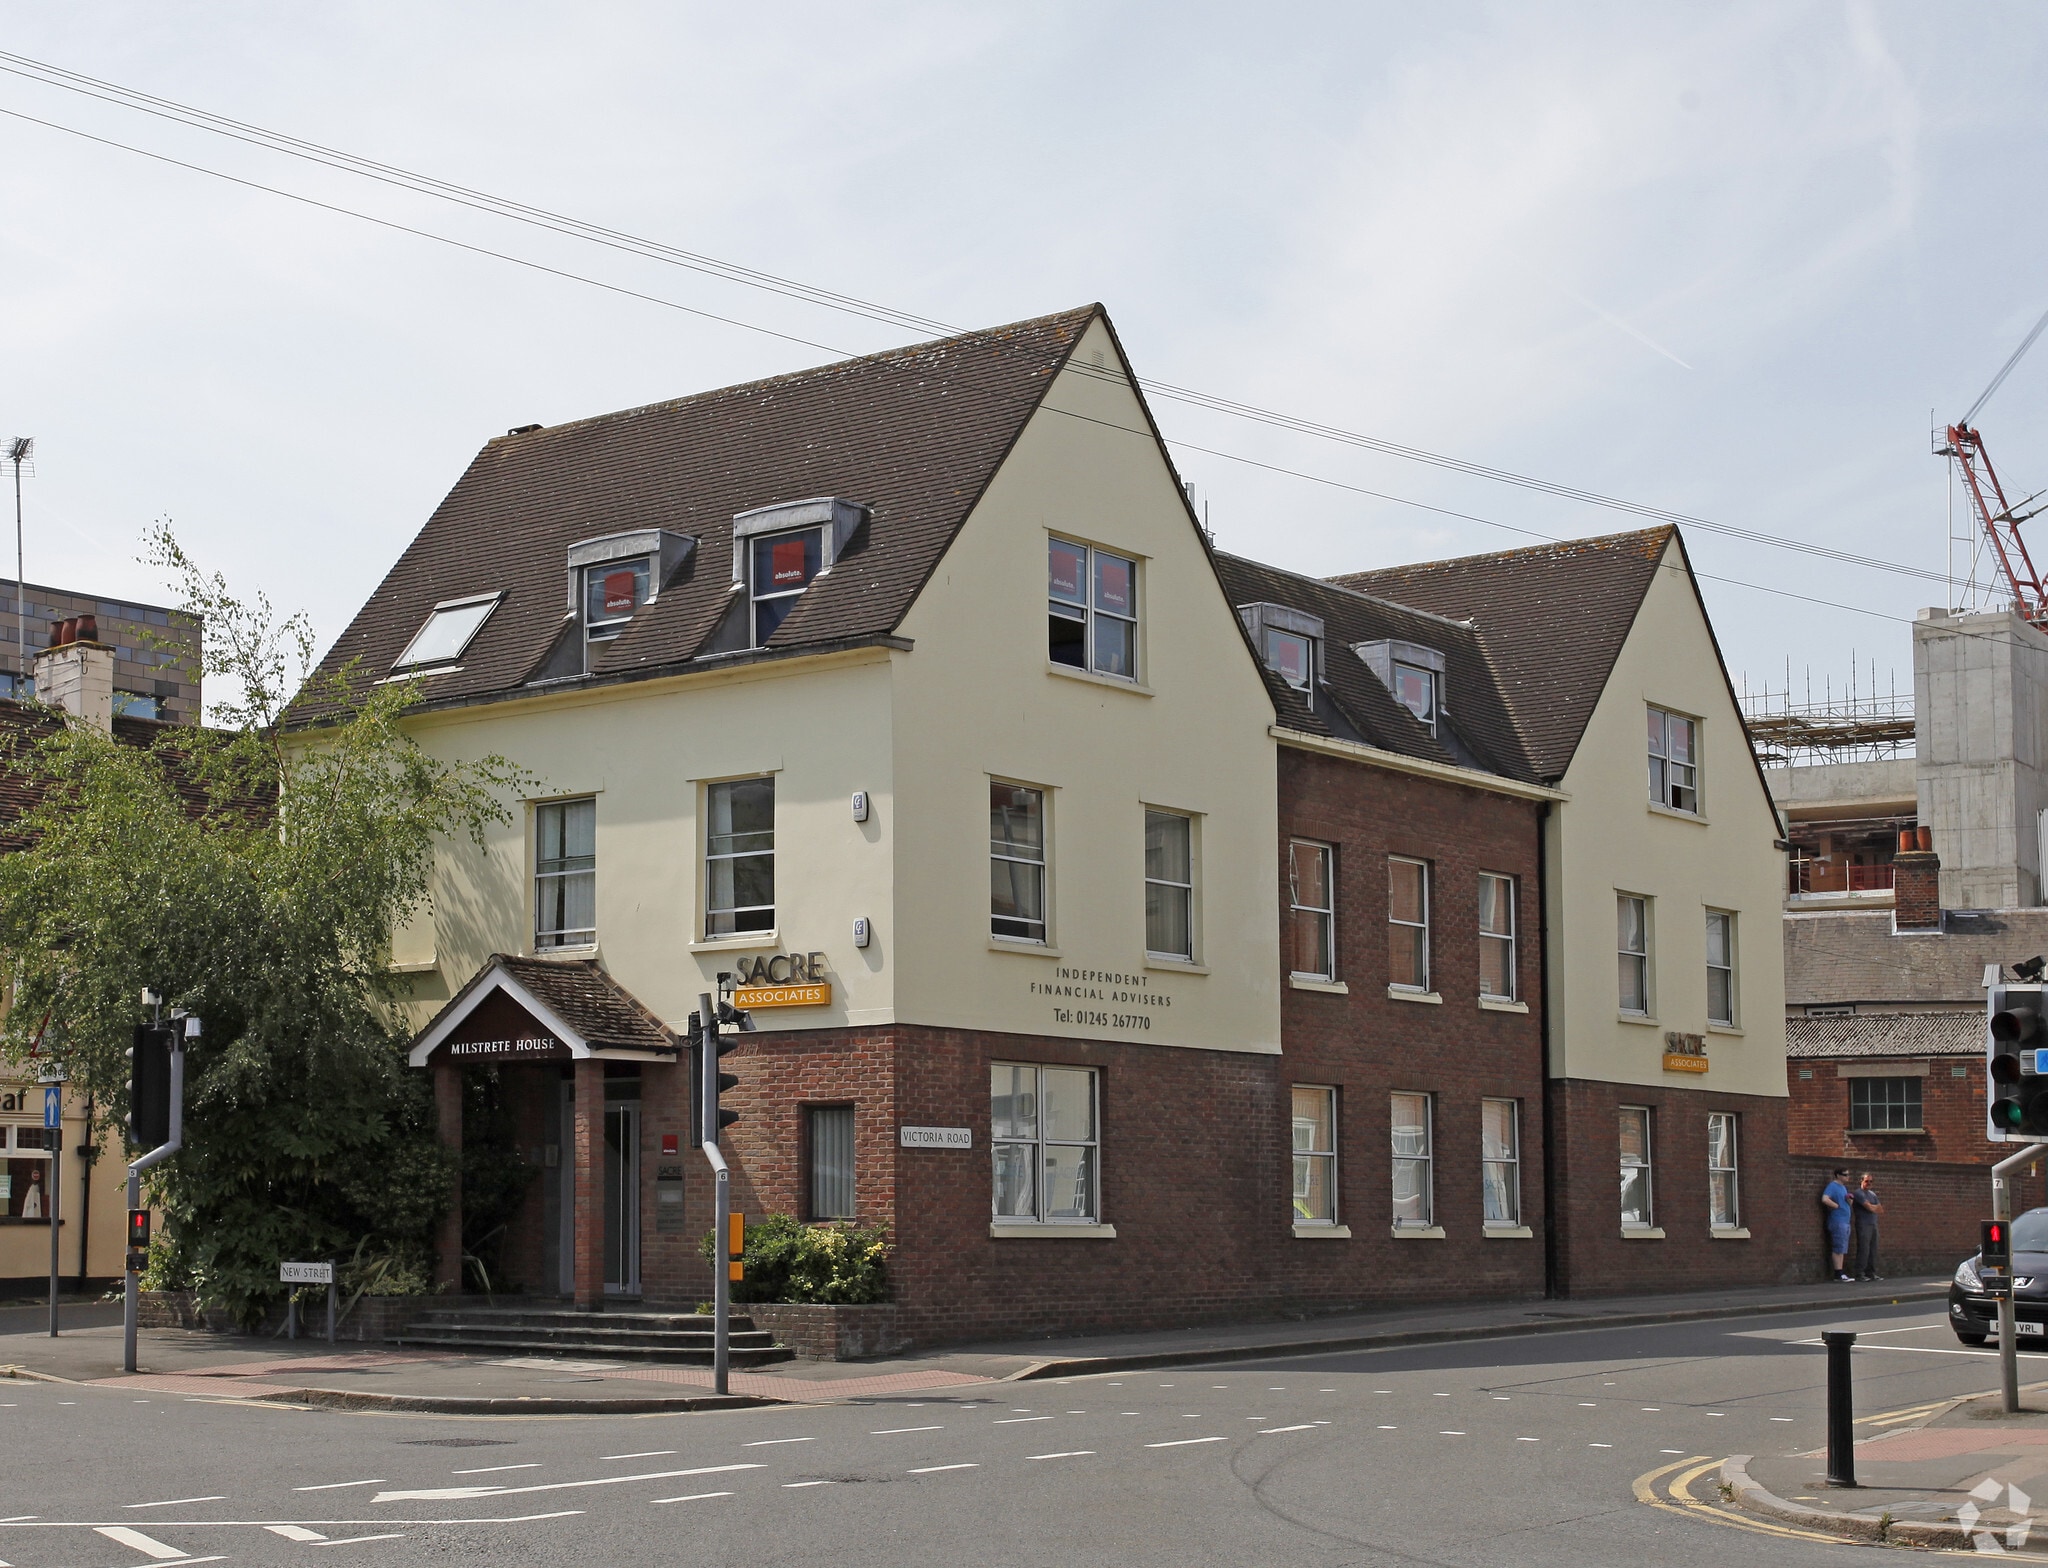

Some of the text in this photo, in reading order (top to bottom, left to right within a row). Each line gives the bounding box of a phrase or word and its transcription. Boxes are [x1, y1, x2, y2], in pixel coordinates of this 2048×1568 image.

[736, 951, 824, 985] SACRE
[1056, 967, 1148, 987] INDEPENDENT
[738, 988, 821, 1004] ASSOCIATES
[1030, 983, 1172, 1007] FINANCIAL ADVISERS
[1053, 1008, 1151, 1030] Tel: 01245 267770
[451, 1038, 555, 1055] MILSTRETE HOUSE
[1670, 1058, 1707, 1069] ASSOCIATES
[0, 1088, 25, 1111] af
[903, 1131, 970, 1144] VICTORIA ROAD
[282, 1267, 301, 1277] NEW
[2019, 1323, 2038, 1334] VRL
